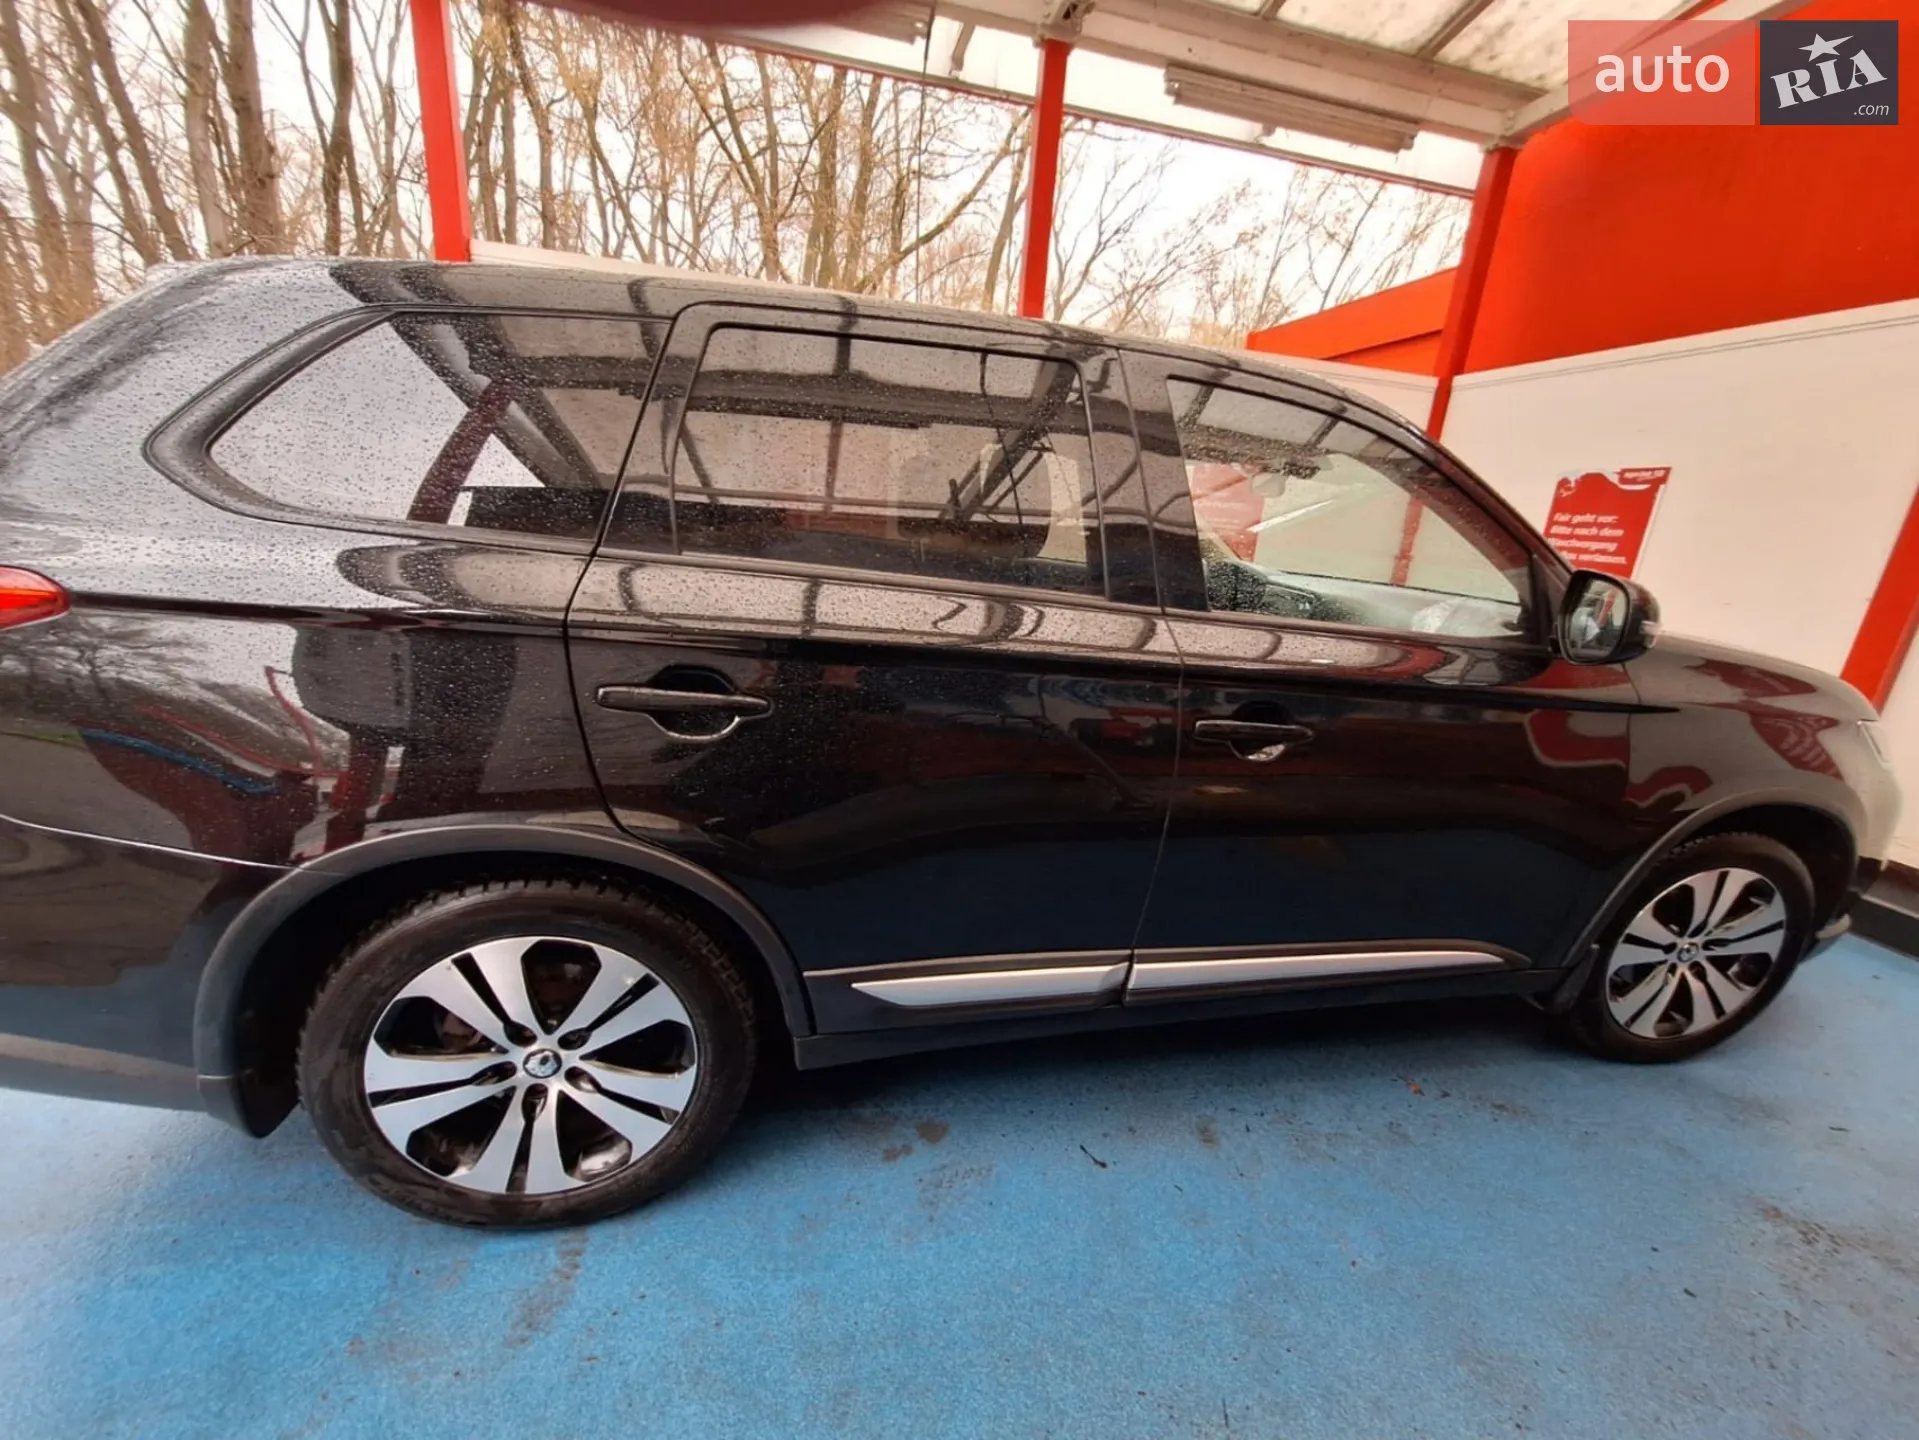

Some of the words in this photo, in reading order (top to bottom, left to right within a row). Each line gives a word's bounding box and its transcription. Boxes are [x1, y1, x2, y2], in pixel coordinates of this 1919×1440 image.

[1553, 512, 1572, 522] Fair
[1571, 513, 1596, 524] geht
[1550, 525, 1573, 535] Bitte
[1573, 526, 1598, 536] nach
[1599, 528, 1624, 537] dem
